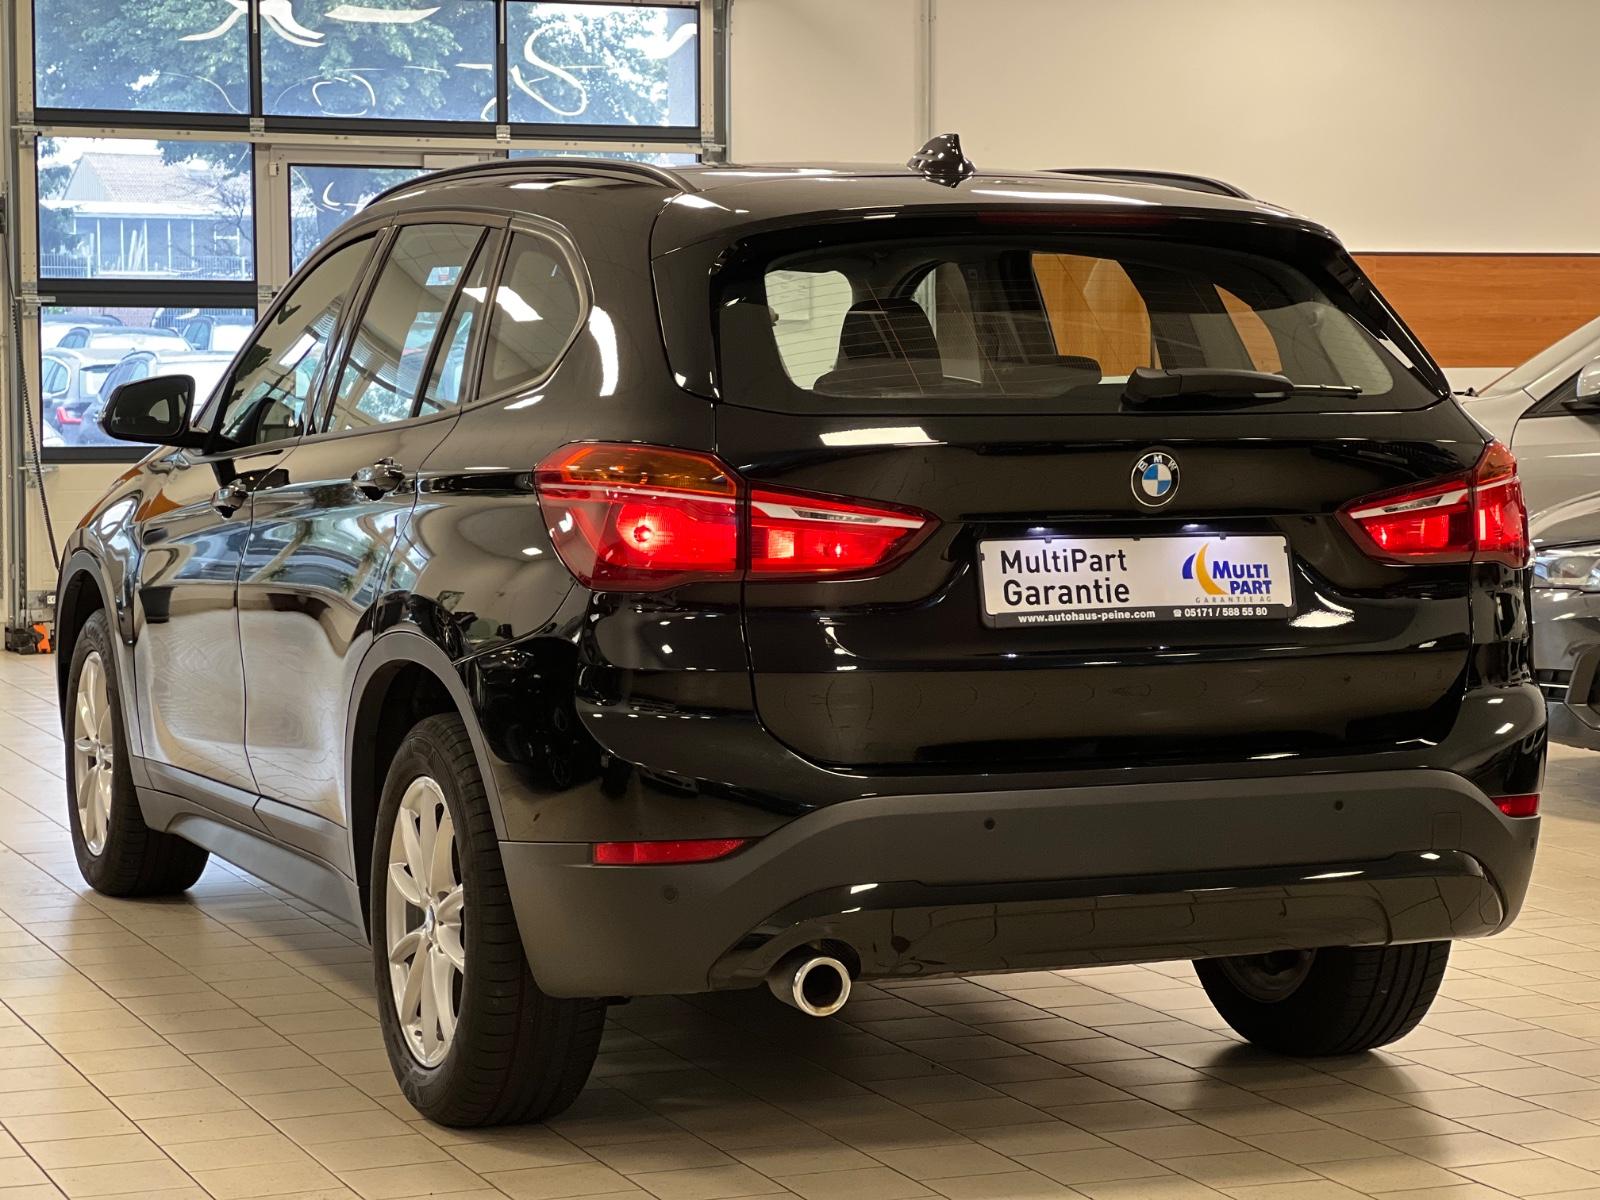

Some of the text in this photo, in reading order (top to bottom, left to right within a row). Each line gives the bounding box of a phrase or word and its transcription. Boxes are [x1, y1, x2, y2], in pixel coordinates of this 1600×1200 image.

[1137, 454, 1177, 471] BMW
[1001, 549, 1127, 574] MultiPart
[1212, 560, 1269, 579] MULTI
[1003, 578, 1130, 606] Garantie
[1230, 580, 1272, 595] PART
[1018, 610, 1155, 623] www.autohaus-peine.com
[1184, 607, 1213, 617] 05171
[1222, 607, 1240, 616] 588
[1242, 607, 1253, 616] 55
[1255, 607, 1268, 616] 80
